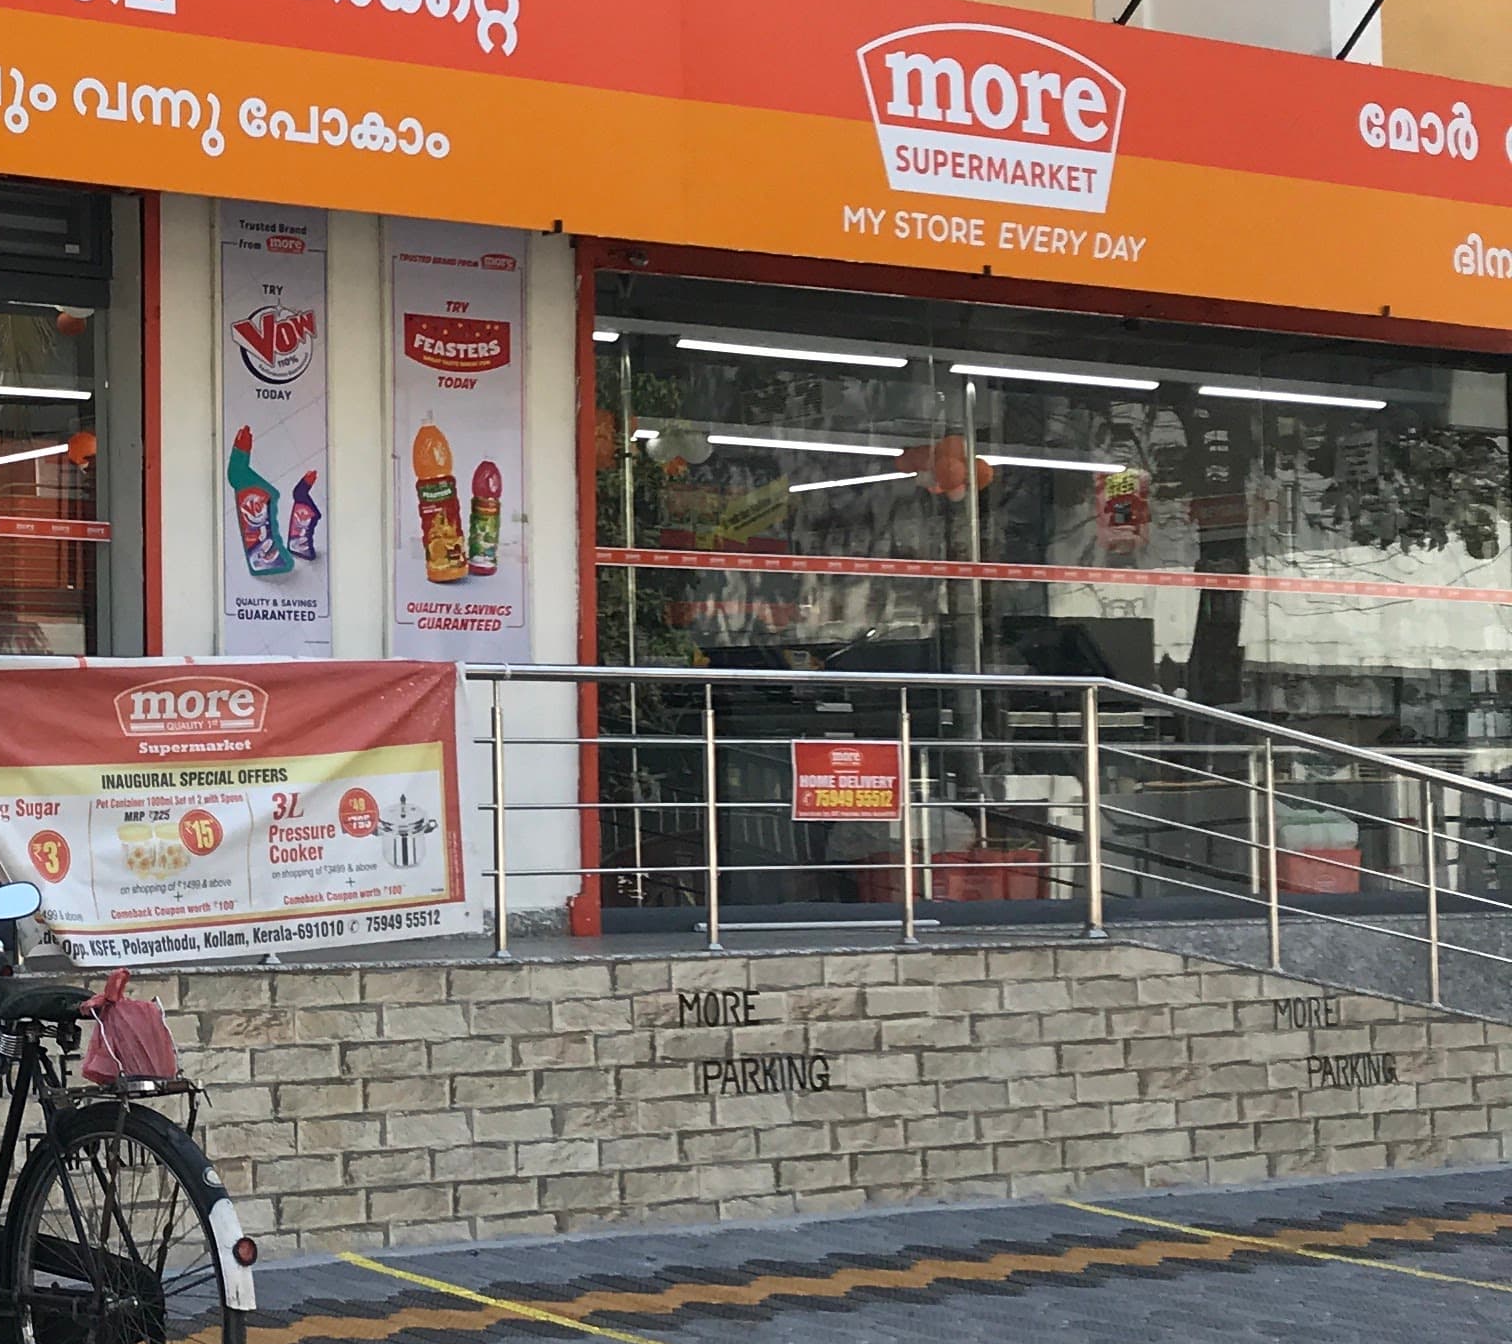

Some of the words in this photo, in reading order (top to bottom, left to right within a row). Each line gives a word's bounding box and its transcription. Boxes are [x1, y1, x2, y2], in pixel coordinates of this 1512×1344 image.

[886, 49, 1108, 142] more
[74, 76, 225, 157] വന്നു
[239, 97, 450, 159] പോകാം
[1359, 102, 1479, 160] മോർ
[895, 144, 1097, 194] SUPERMARKET
[239, 220, 276, 232] Trusted
[278, 223, 307, 234] Brand
[843, 205, 886, 235] MY
[894, 210, 985, 247] STORE
[999, 221, 1087, 256] EVERY
[1093, 232, 1147, 263] DAY
[270, 237, 302, 249] more
[262, 285, 283, 296] TRY
[446, 301, 469, 313] TRY
[414, 334, 500, 358] FEASTERS
[438, 376, 477, 389] TODAY
[256, 389, 292, 400] TODAY
[235, 597, 270, 607] QUALITY
[280, 599, 317, 608] SAVINGS
[407, 602, 453, 614] QUALITY
[463, 604, 512, 616] SAVINGS
[237, 609, 316, 622] GUARANTEED
[417, 618, 502, 632] GUARANTEED
[130, 688, 255, 720] more
[166, 721, 203, 731] QUALITY
[139, 739, 251, 756] Supermarket
[102, 773, 176, 789] INAUGURAL
[180, 770, 234, 787] SPECIAL
[239, 768, 288, 785] OFFERS
[799, 774, 836, 788] HOME
[838, 775, 896, 789] DELIVERY
[96, 799, 109, 808] Pet
[110, 798, 145, 809] Container
[272, 792, 304, 821] 3L
[814, 789, 854, 807] 75949
[856, 790, 893, 807] 55512
[15, 799, 60, 819] Sugar
[124, 812, 144, 822] MRP
[269, 824, 335, 843] Pressure
[269, 845, 324, 864] Cooker
[282, 867, 314, 878] shopping
[355, 863, 378, 872] above
[131, 883, 166, 894] shopping
[209, 878, 232, 888] above
[283, 893, 324, 906] Comeback
[327, 891, 357, 902] Coupon
[111, 908, 152, 920] Comeback
[155, 906, 186, 918] Coupon
[187, 904, 211, 913] worth
[63, 939, 89, 960] Opp.
[89, 940, 121, 958] KSFE,
[124, 933, 200, 957] Polayathodu,
[204, 929, 249, 949] Kollam,
[253, 919, 344, 944] Kerala-691010
[366, 915, 402, 932] 75949
[405, 909, 441, 929] 55512
[678, 990, 761, 1028] MORE
[1272, 996, 1338, 1030] MORE
[703, 1054, 832, 1095] PARKING
[1307, 1052, 1400, 1088] PARKING
